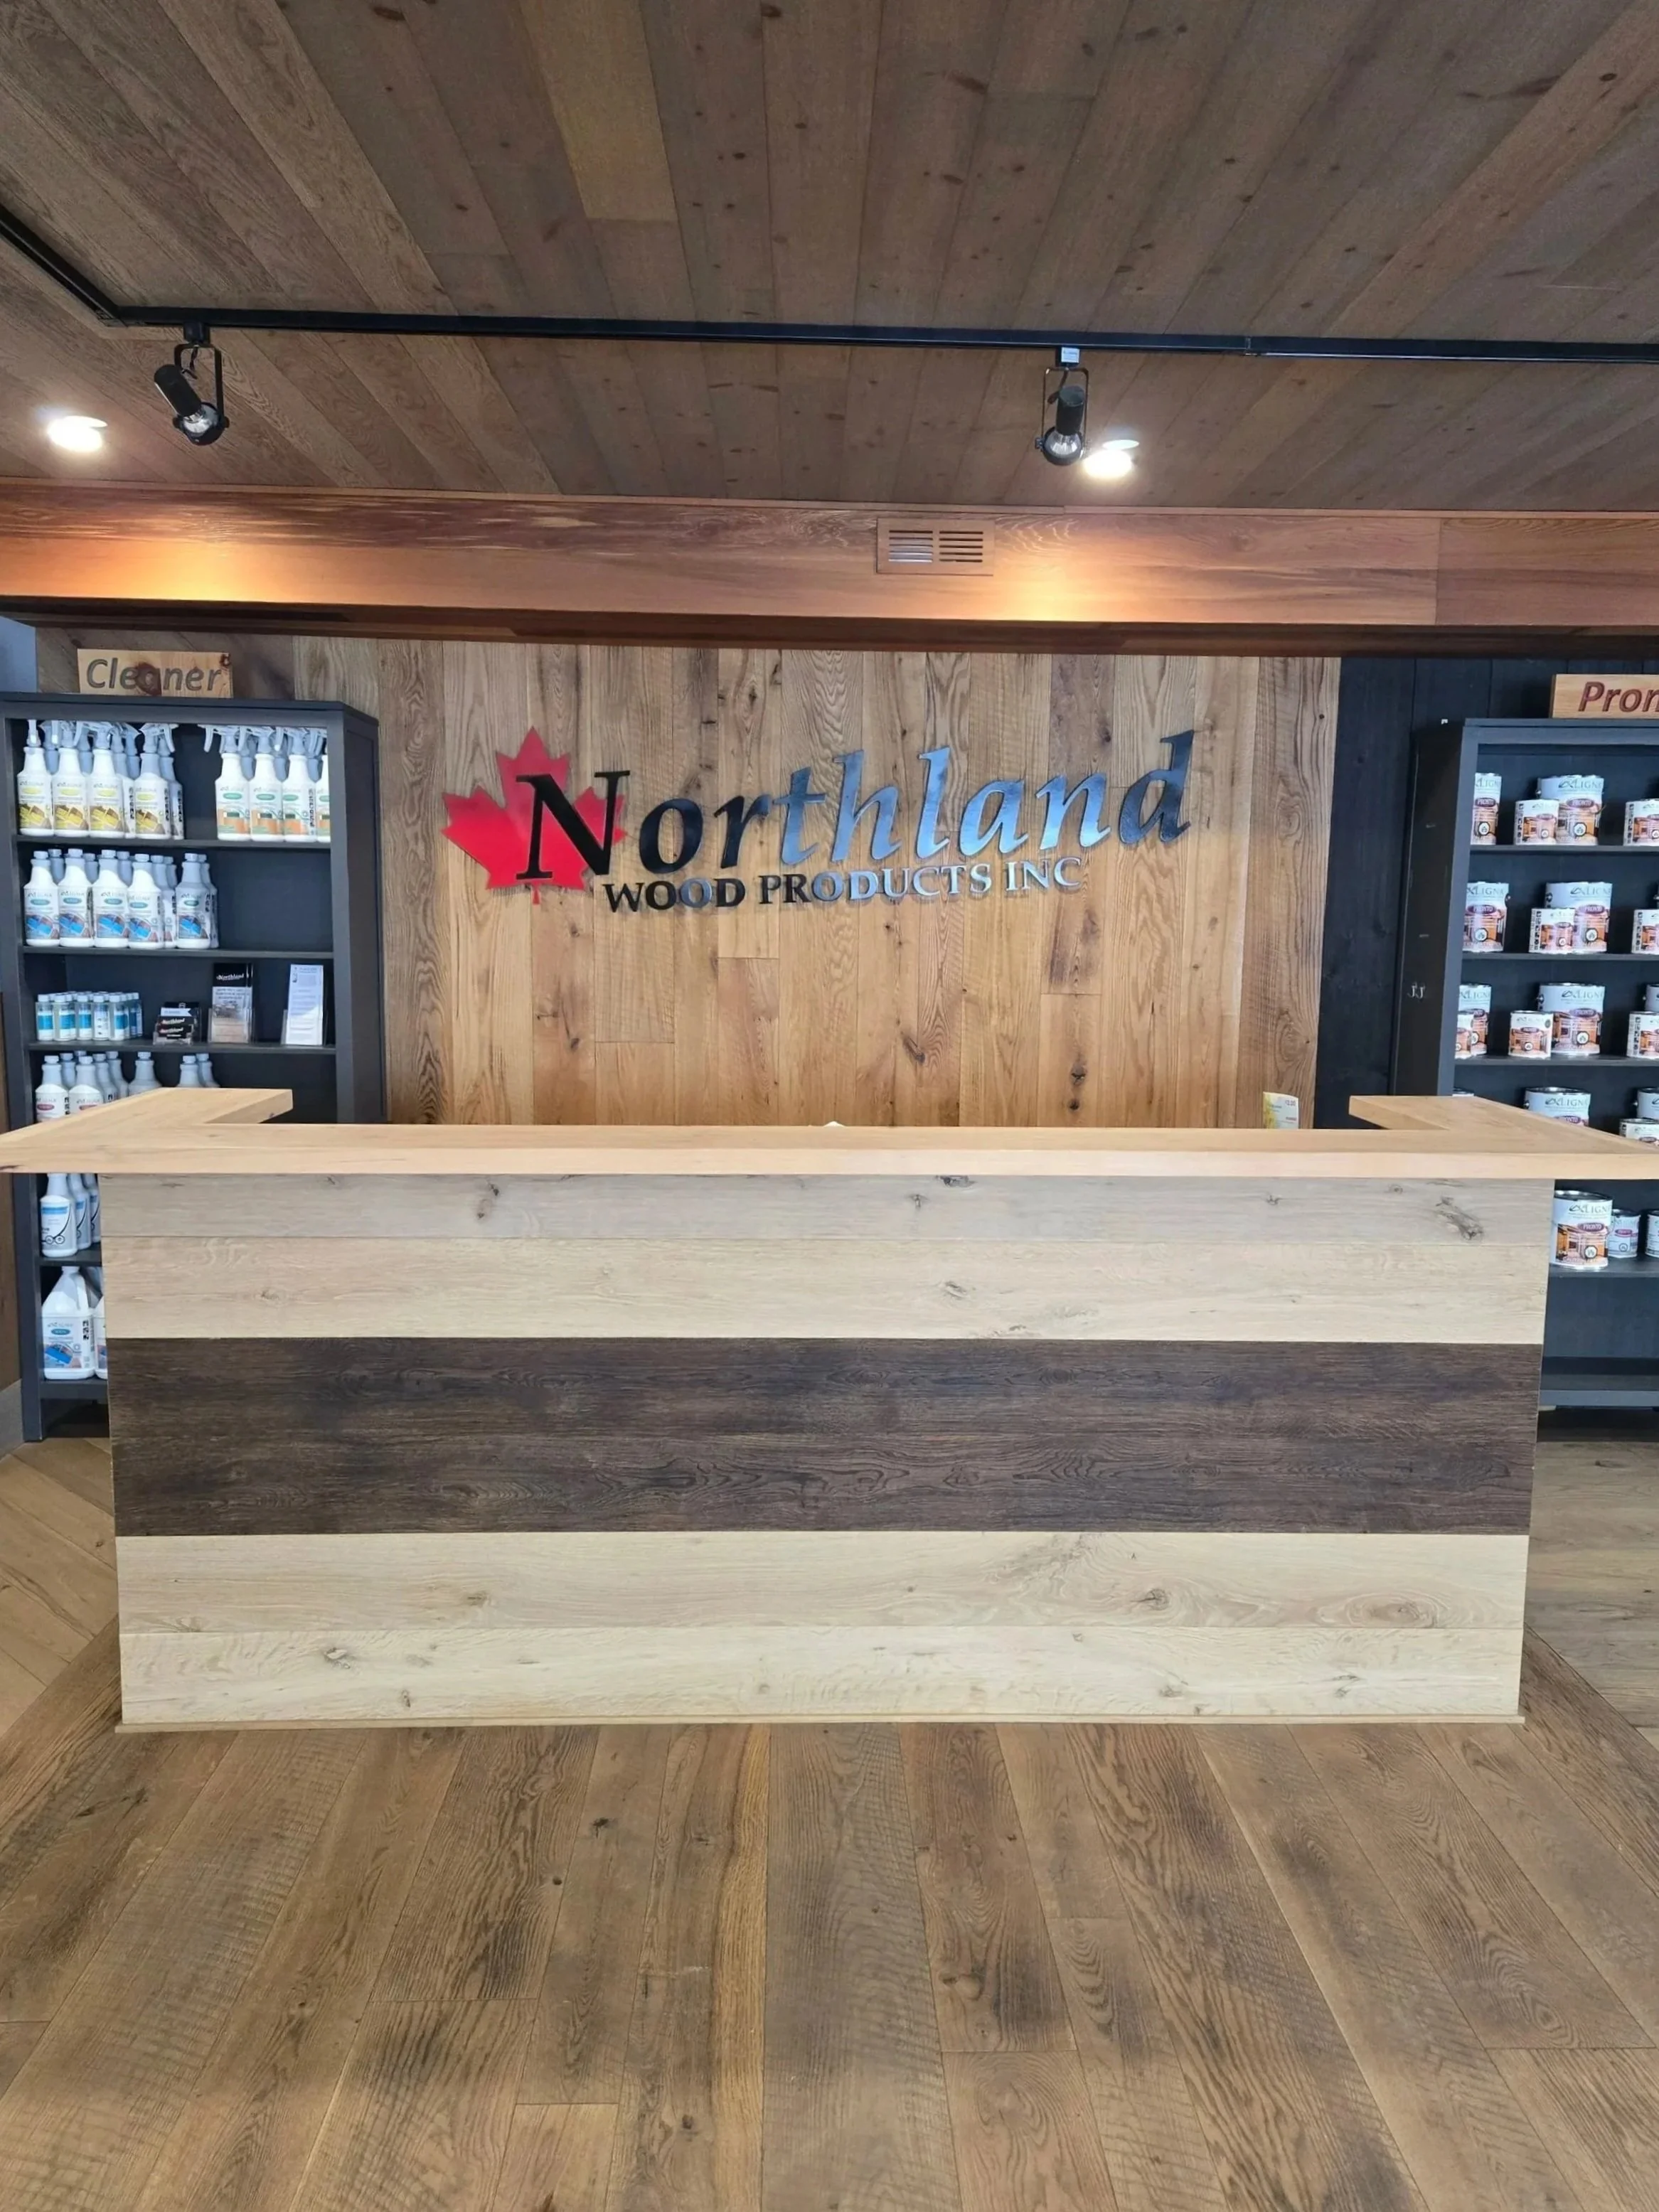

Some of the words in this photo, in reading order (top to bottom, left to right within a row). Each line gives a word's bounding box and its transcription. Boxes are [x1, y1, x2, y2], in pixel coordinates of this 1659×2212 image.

[87, 658, 222, 691] Cleaner
[516, 730, 1194, 880] Northland
[602, 877, 746, 913] WOOD
[758, 862, 993, 904] PRODUCTS
[1005, 856, 1082, 892] INC
